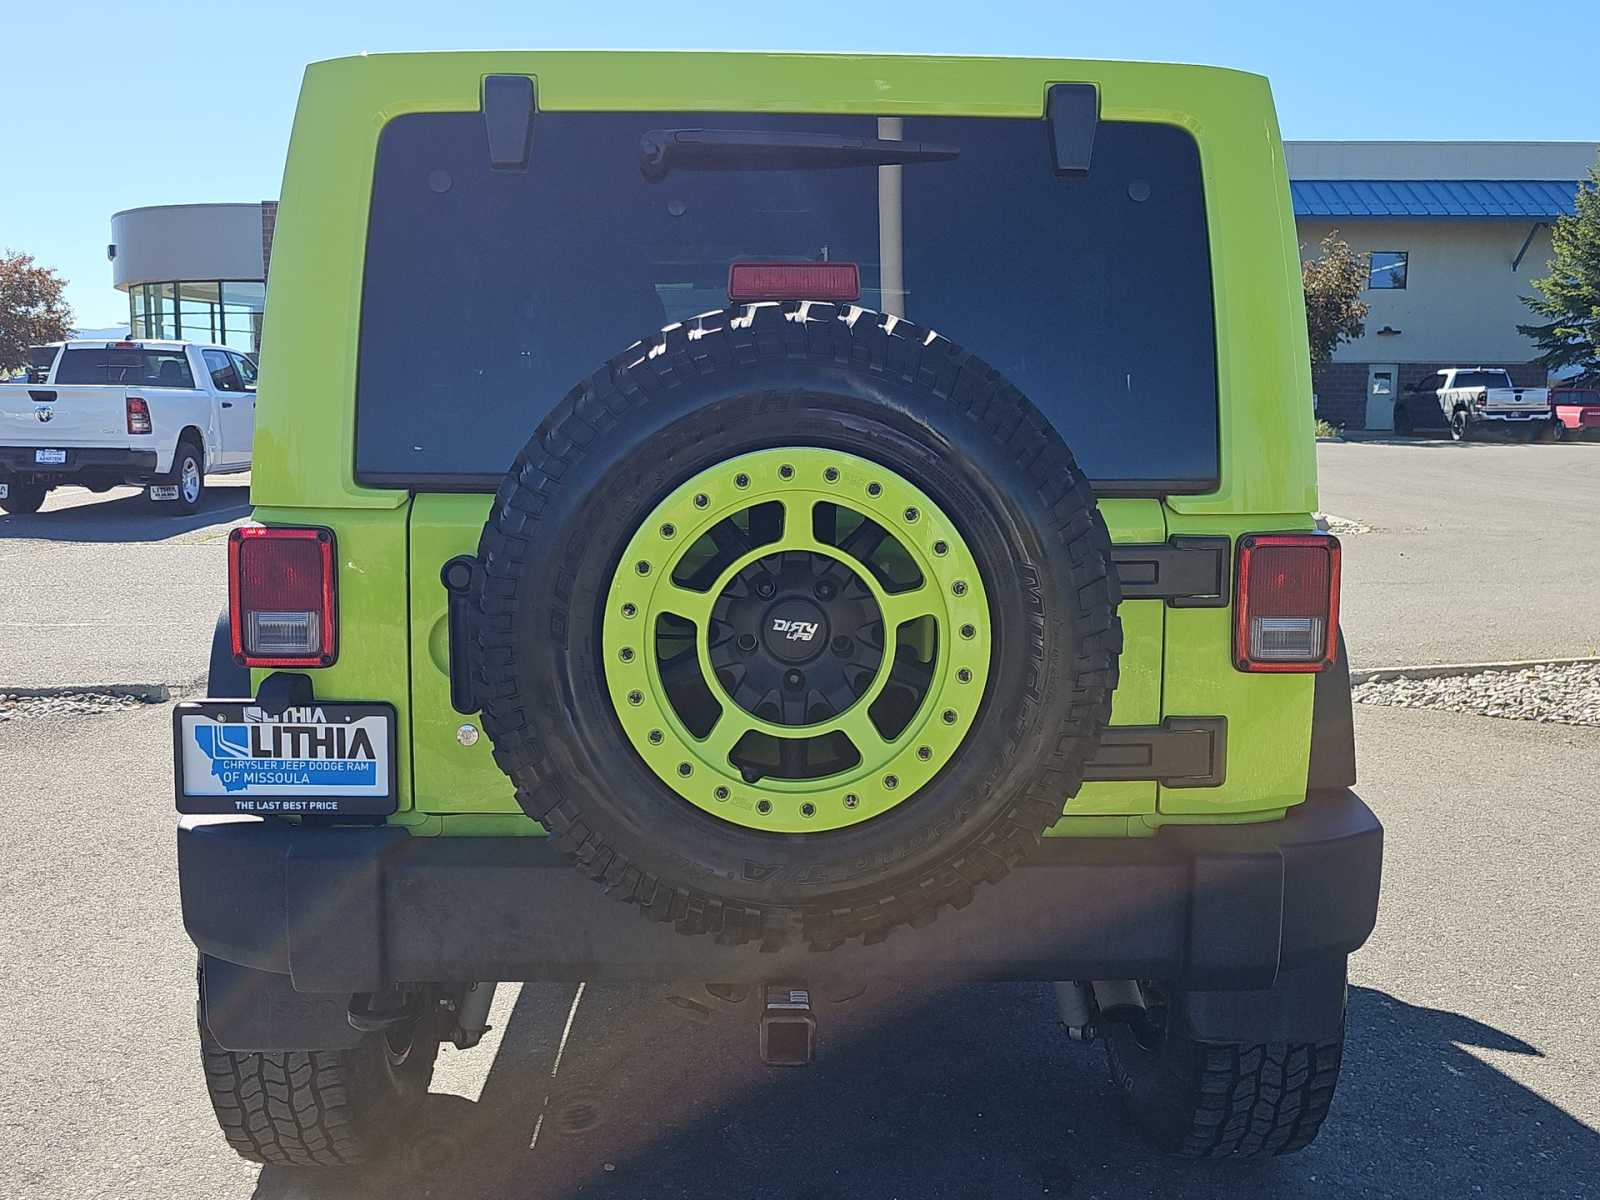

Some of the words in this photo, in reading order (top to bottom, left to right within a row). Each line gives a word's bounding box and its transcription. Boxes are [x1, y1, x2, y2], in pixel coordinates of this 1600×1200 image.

[251, 725, 376, 760] LITHIA
[223, 760, 278, 770] CHRYSLER
[280, 761, 306, 771] JEEP
[308, 761, 344, 771] DODGE
[346, 762, 369, 771] RAM
[223, 771, 240, 783] OF
[243, 772, 310, 784] MISSOULA
[234, 801, 254, 810] THE
[256, 801, 281, 810] LAST
[282, 801, 308, 810] BEST
[309, 801, 338, 810] PRICE
